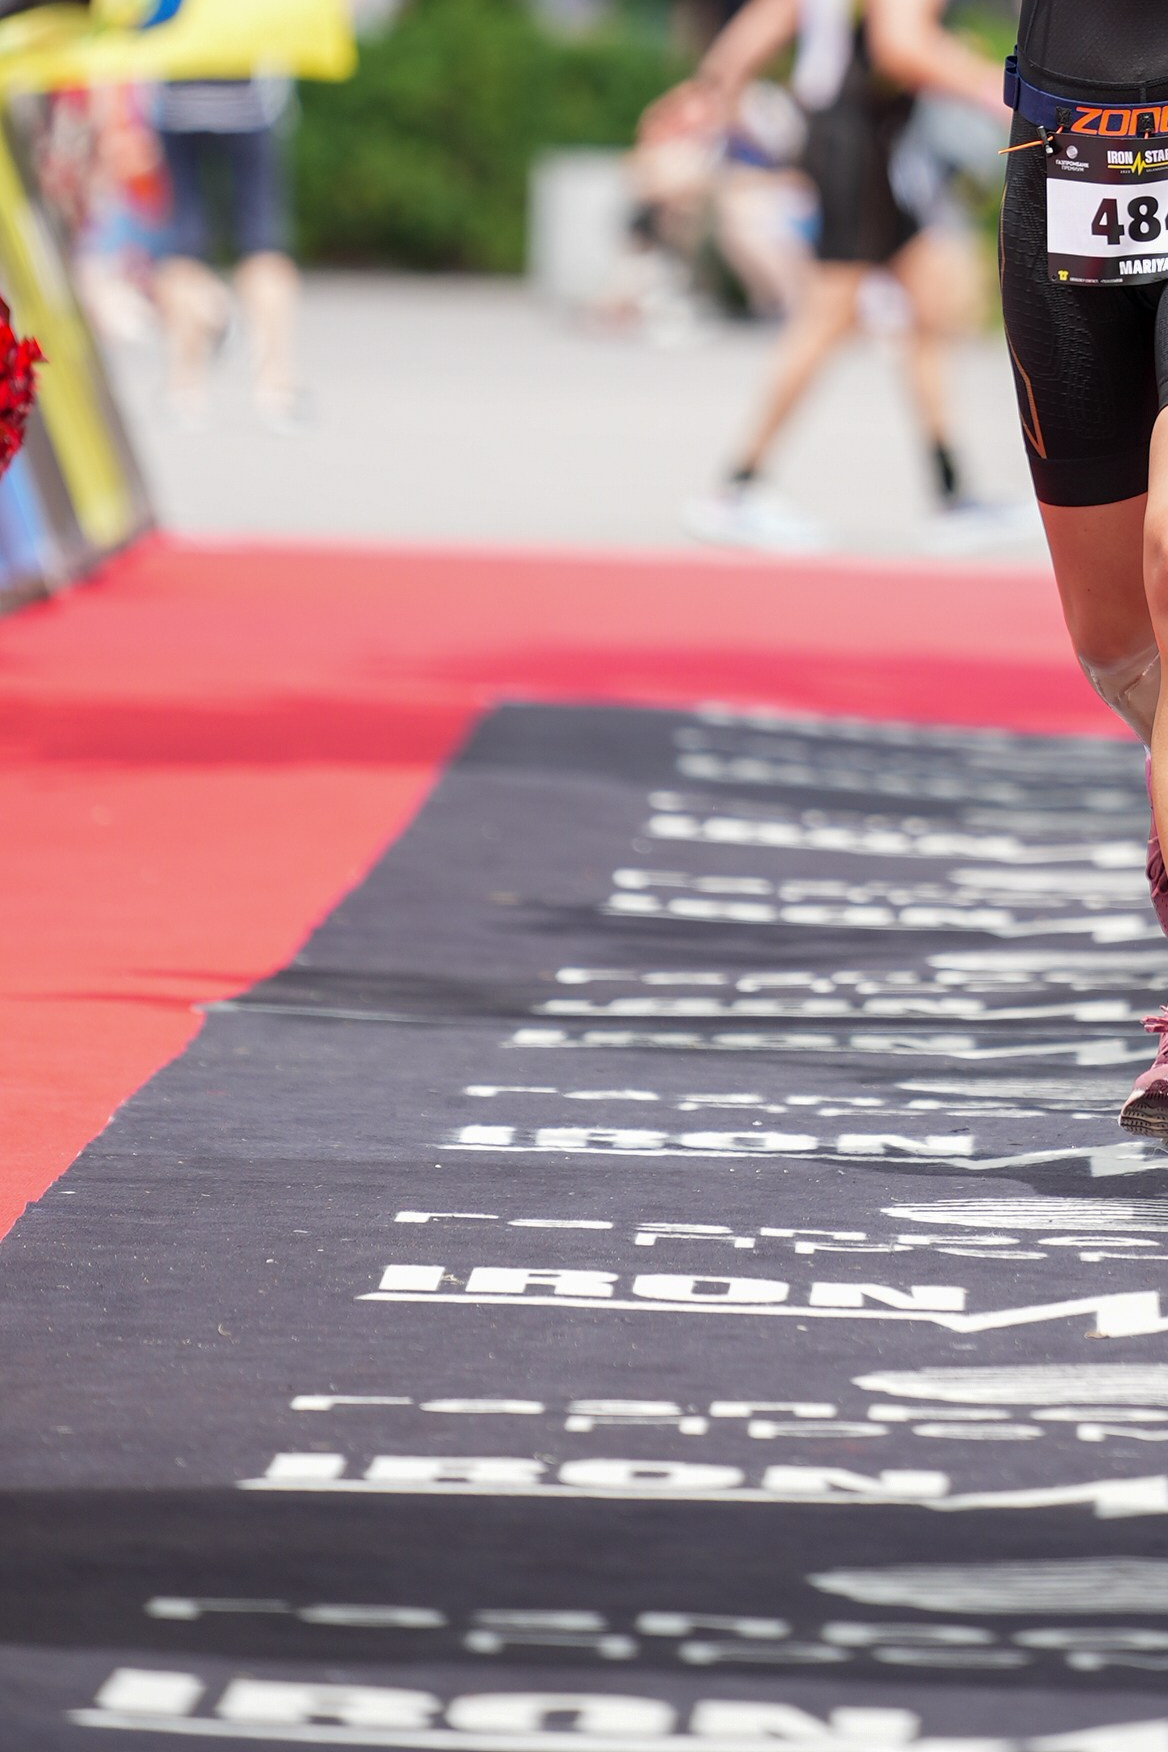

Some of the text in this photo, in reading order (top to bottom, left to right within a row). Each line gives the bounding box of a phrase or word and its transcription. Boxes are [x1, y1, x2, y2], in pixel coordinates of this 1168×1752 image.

[1107, 150, 1133, 165] IRON
[457, 1124, 975, 1157] IRON
[378, 1263, 967, 1311] IRON
[264, 1452, 950, 1498] IRON
[95, 1666, 921, 1748] IRON
